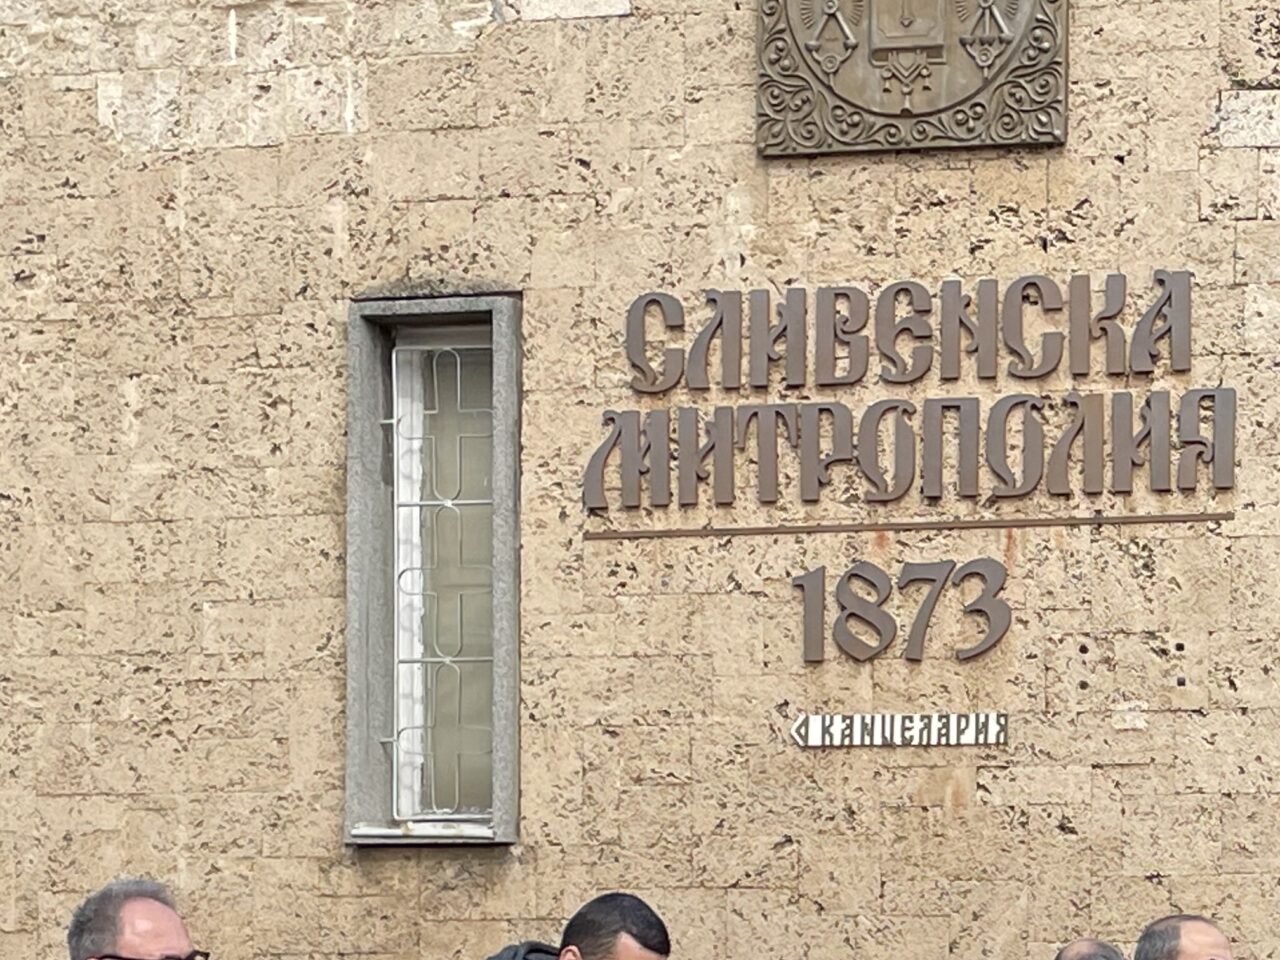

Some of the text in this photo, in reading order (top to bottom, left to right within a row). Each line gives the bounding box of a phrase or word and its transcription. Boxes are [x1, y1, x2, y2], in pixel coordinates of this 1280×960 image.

[624, 270, 1193, 393] СЛИВЕНСКА
[582, 387, 1236, 510] МИТРОПОЛИЯ
[792, 557, 1012, 663] 1873
[821, 713, 1009, 748] КАНЦЕЛАРИЯ
